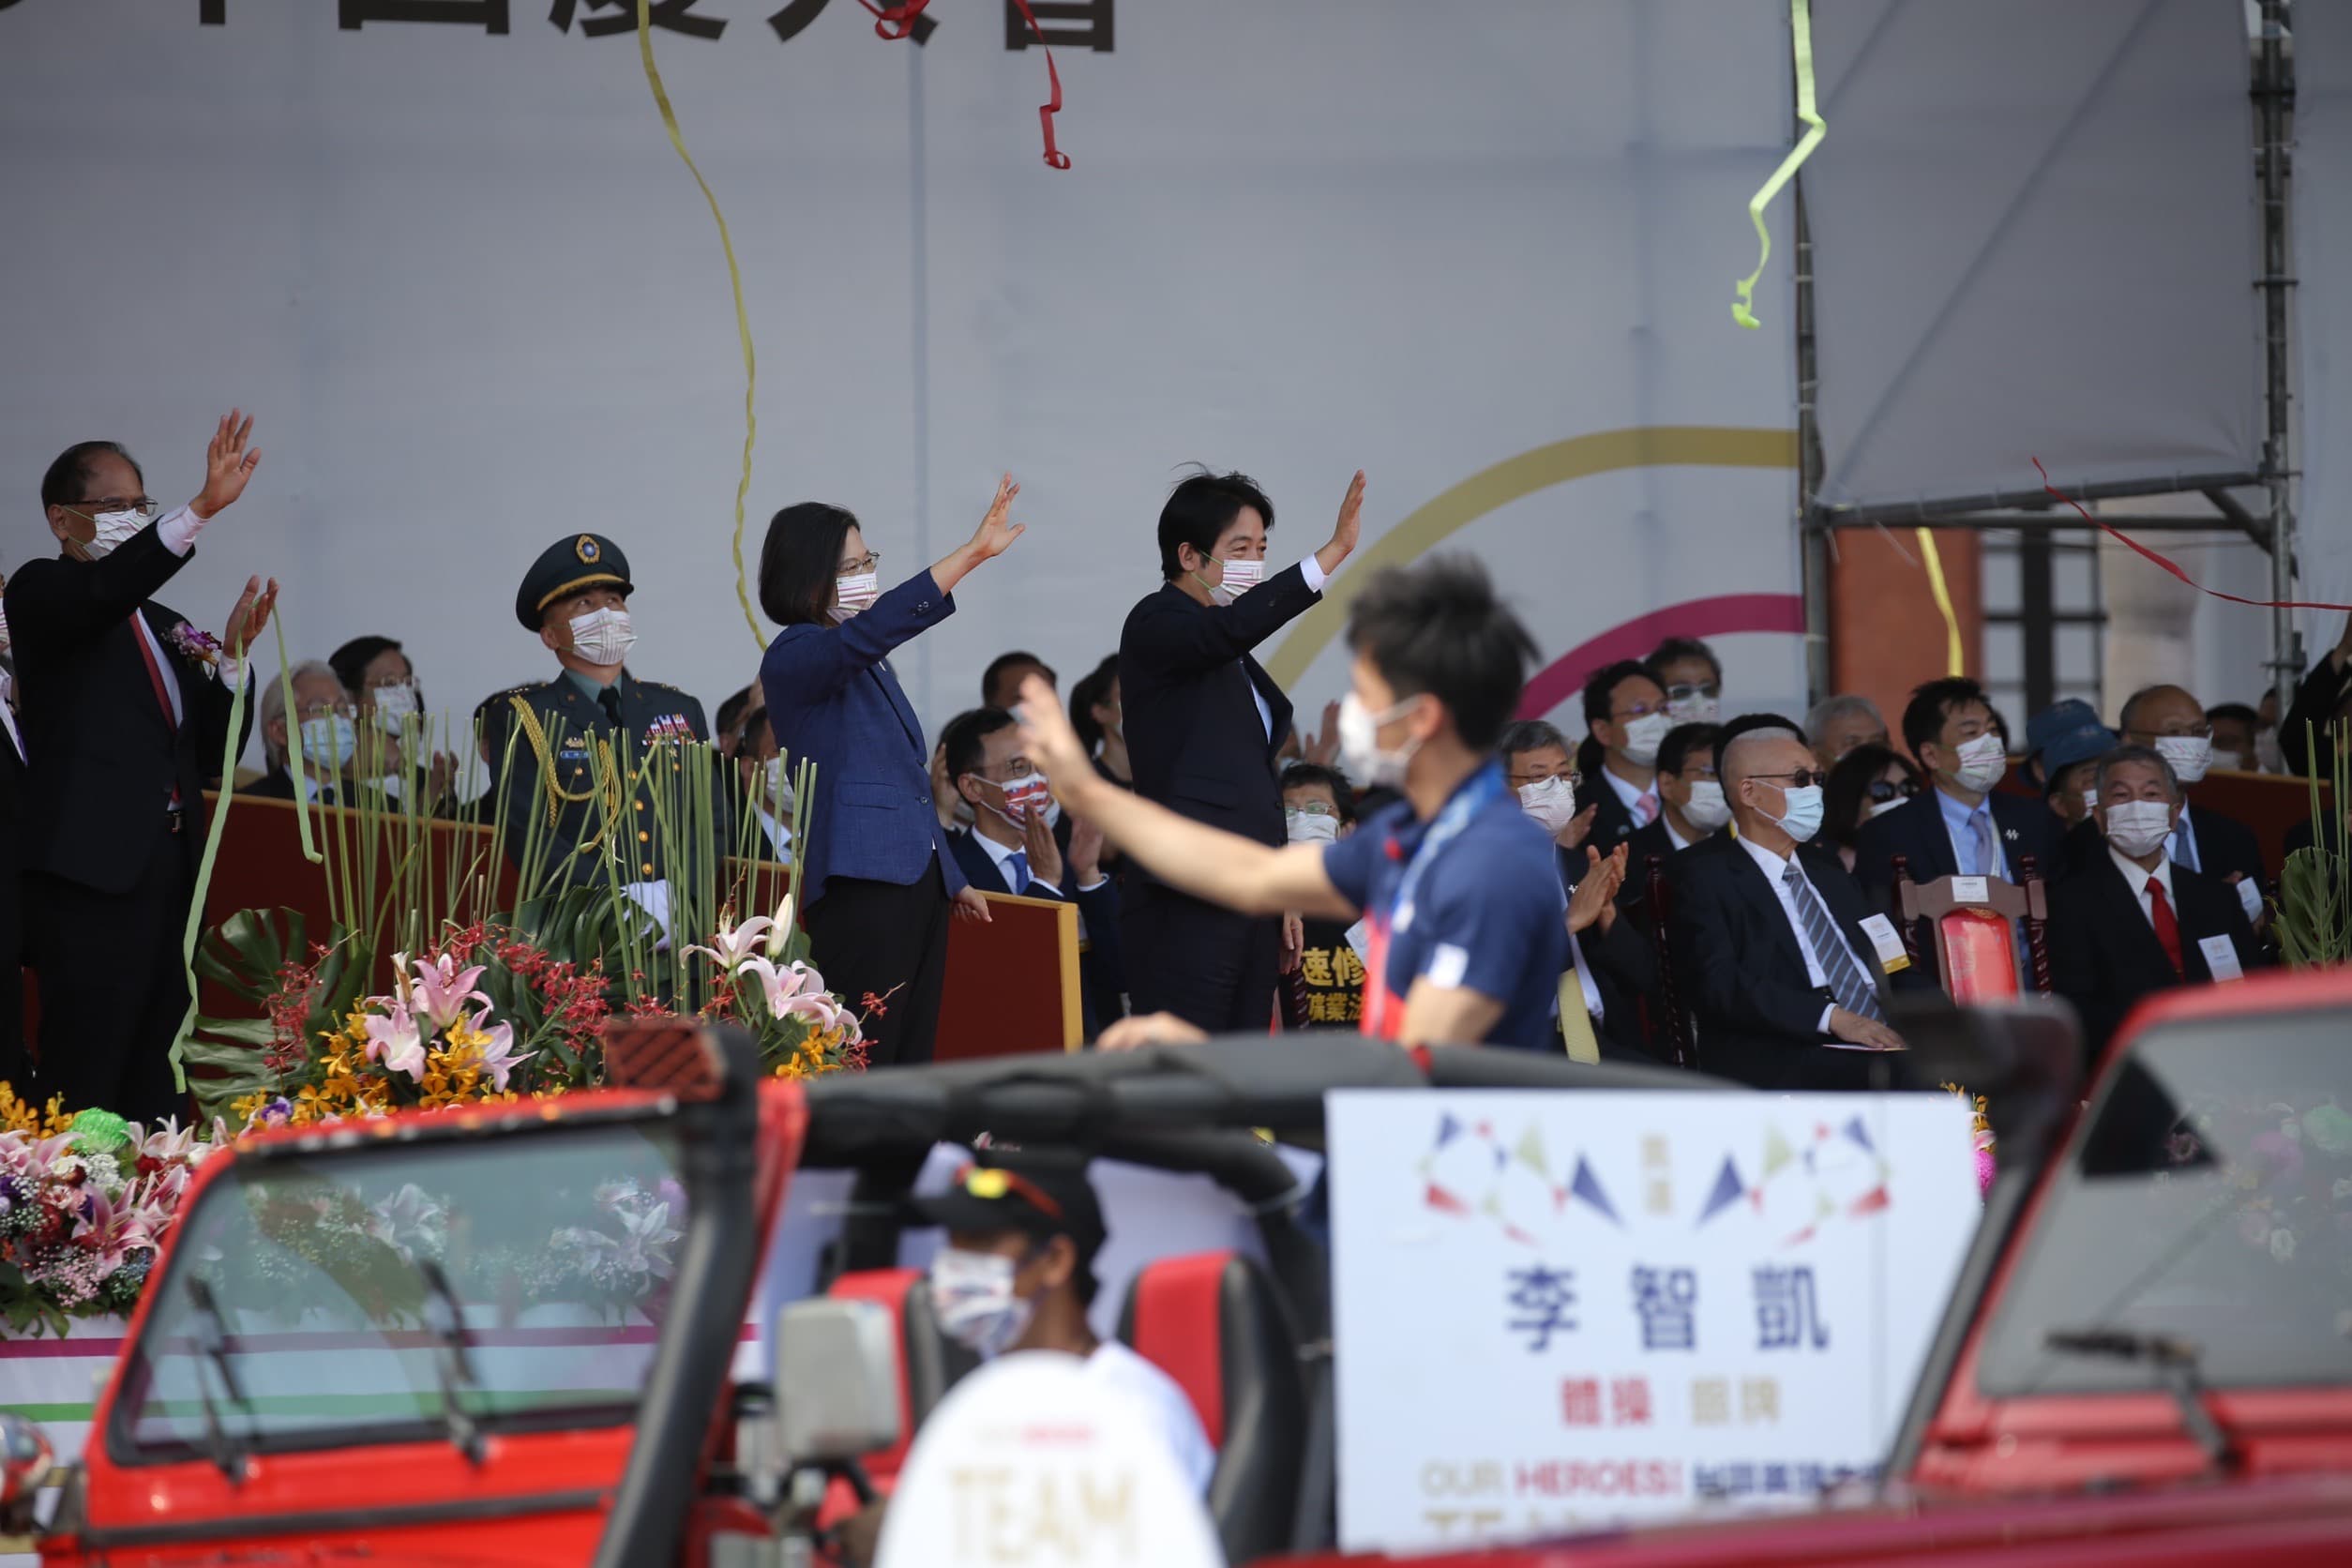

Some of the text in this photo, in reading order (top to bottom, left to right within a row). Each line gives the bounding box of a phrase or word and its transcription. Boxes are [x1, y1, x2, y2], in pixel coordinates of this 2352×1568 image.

[1505, 1262, 1830, 1353] 李智凱
[946, 1465, 1139, 1564] TEAM
[1421, 1460, 1500, 1496] OUR
